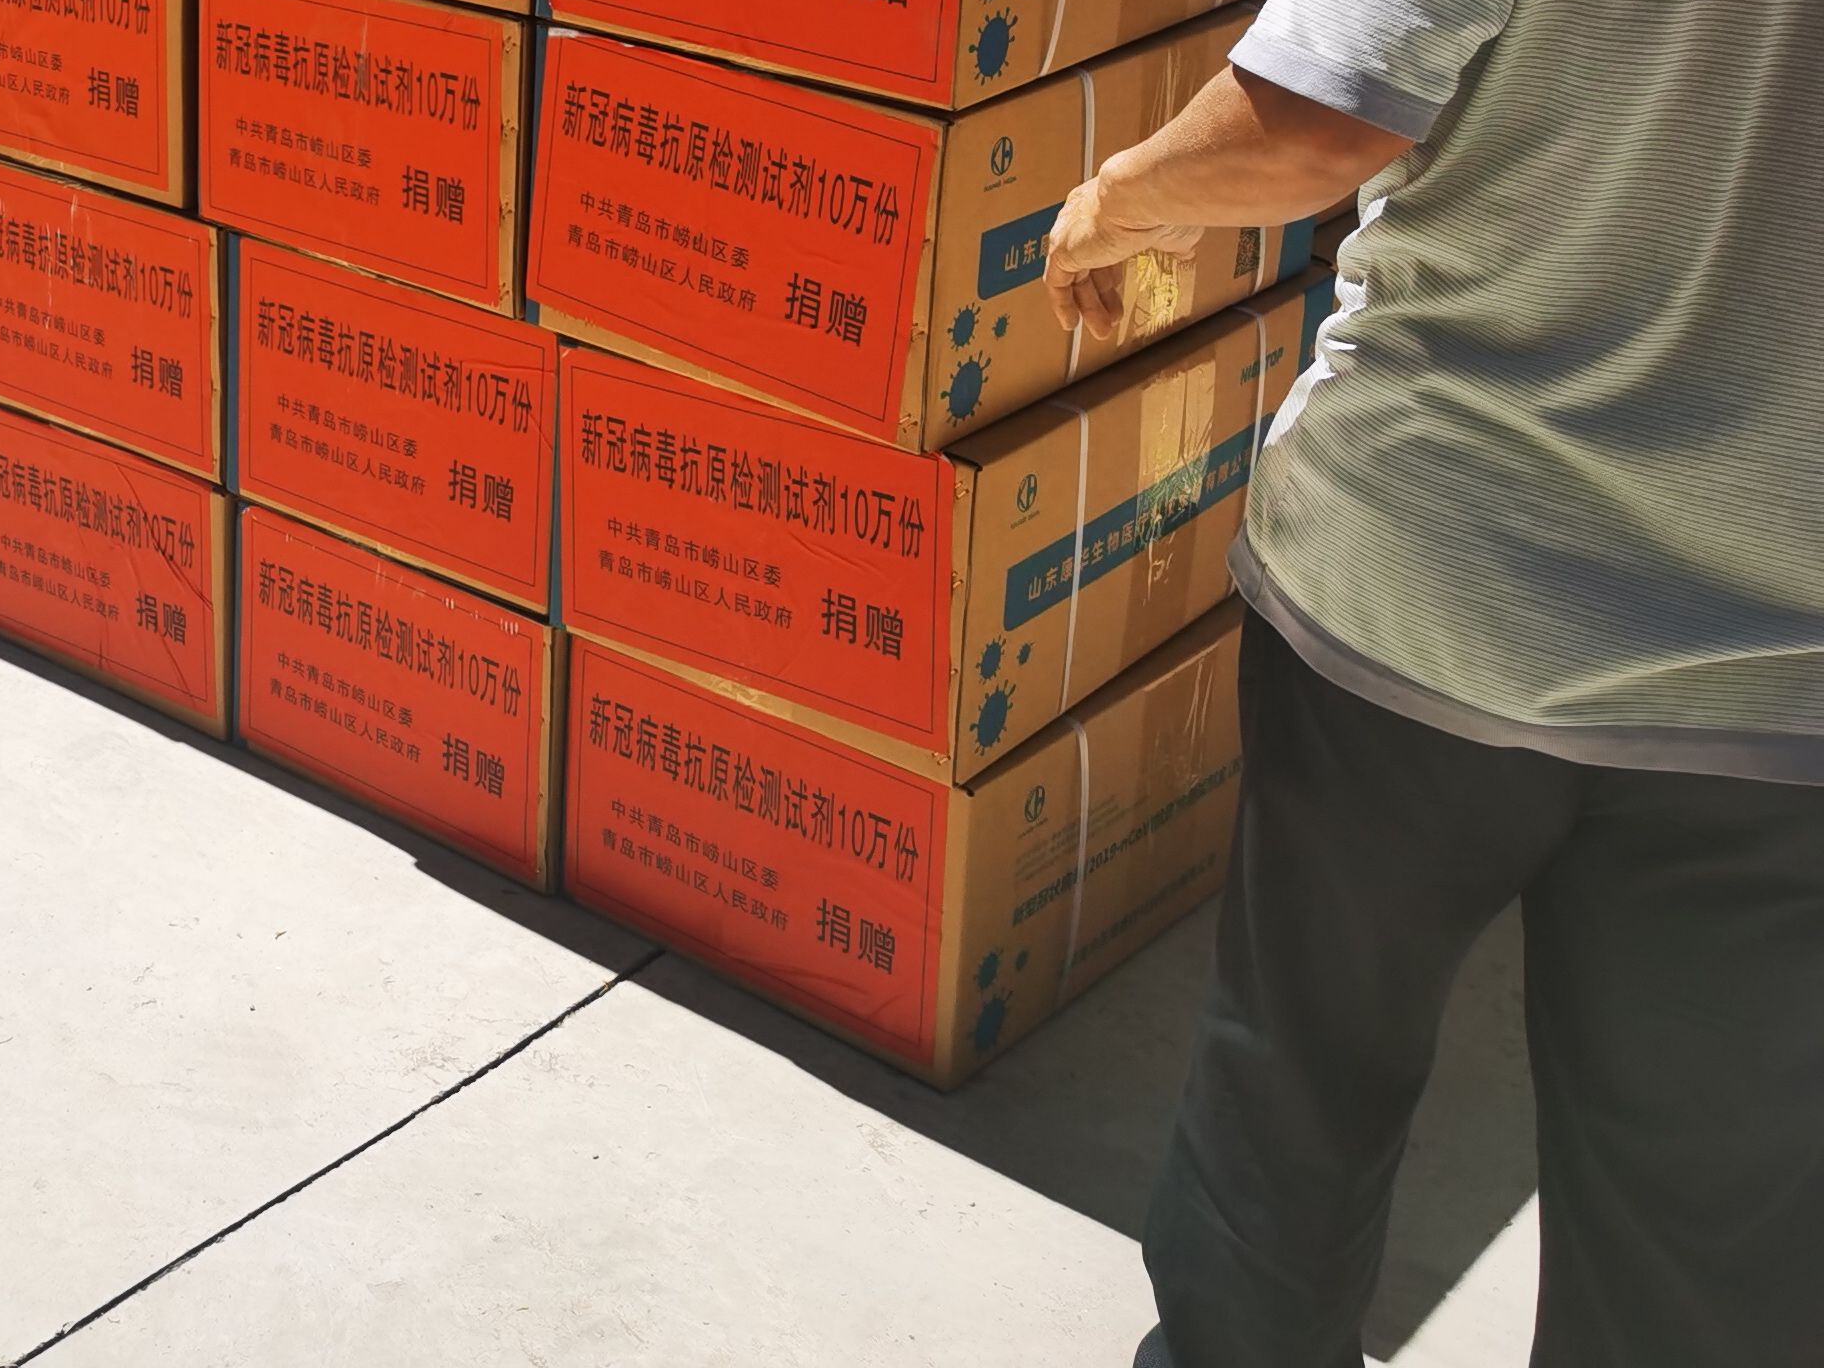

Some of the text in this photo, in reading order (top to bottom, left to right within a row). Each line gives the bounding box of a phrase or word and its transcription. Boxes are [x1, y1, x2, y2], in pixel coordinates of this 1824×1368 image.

[86, 66, 139, 119] 捐赠
[215, 17, 480, 131] 新冠病毒抗原检测试剂10万份
[228, 147, 380, 206] 青岛市崂山区人民政府
[235, 116, 371, 169] 中共青岛市崂山区委
[561, 80, 899, 246] 新冠病毒抗原检测试剂10万份
[401, 163, 465, 226] 捐赠
[579, 192, 749, 270] 中共青岛市崂山区委
[567, 223, 757, 311] 青岛市崂山区人民政府
[783, 271, 867, 348] 捐赠
[129, 344, 183, 402] 捐赠
[256, 296, 532, 434] 新冠病毒抗原检测试剂10万份
[1240, 346, 1284, 386] HIGTOP
[269, 422, 425, 495] 青岛市崂山区人民政府
[276, 394, 417, 459] 中共青岛市崂山区委
[447, 458, 514, 524] 捐赠
[581, 408, 924, 558] 新冠病毒抗原检测试剂10万份
[0, 533, 111, 590] 中共青岛市崂山区委
[598, 549, 792, 629] 青岛市崂山区人民政府
[606, 517, 781, 588] 中共青岛市崂山区委
[134, 589, 186, 646] 捐赠
[258, 557, 521, 717] 新冠病毒抗原检测试剂10万份
[820, 587, 903, 661] 捐赠
[269, 677, 420, 763] 青岛市崂山区人民政府
[276, 651, 412, 728] 中共青岛市崂山区委
[441, 731, 505, 800] 捐赠
[588, 692, 918, 883] 新冠病毒抗原检测试剂10万份
[601, 827, 788, 930] 青岛市崂山区人民政府
[610, 799, 778, 890] 中共青岛市崂山区委
[815, 896, 895, 976] 捐赠
